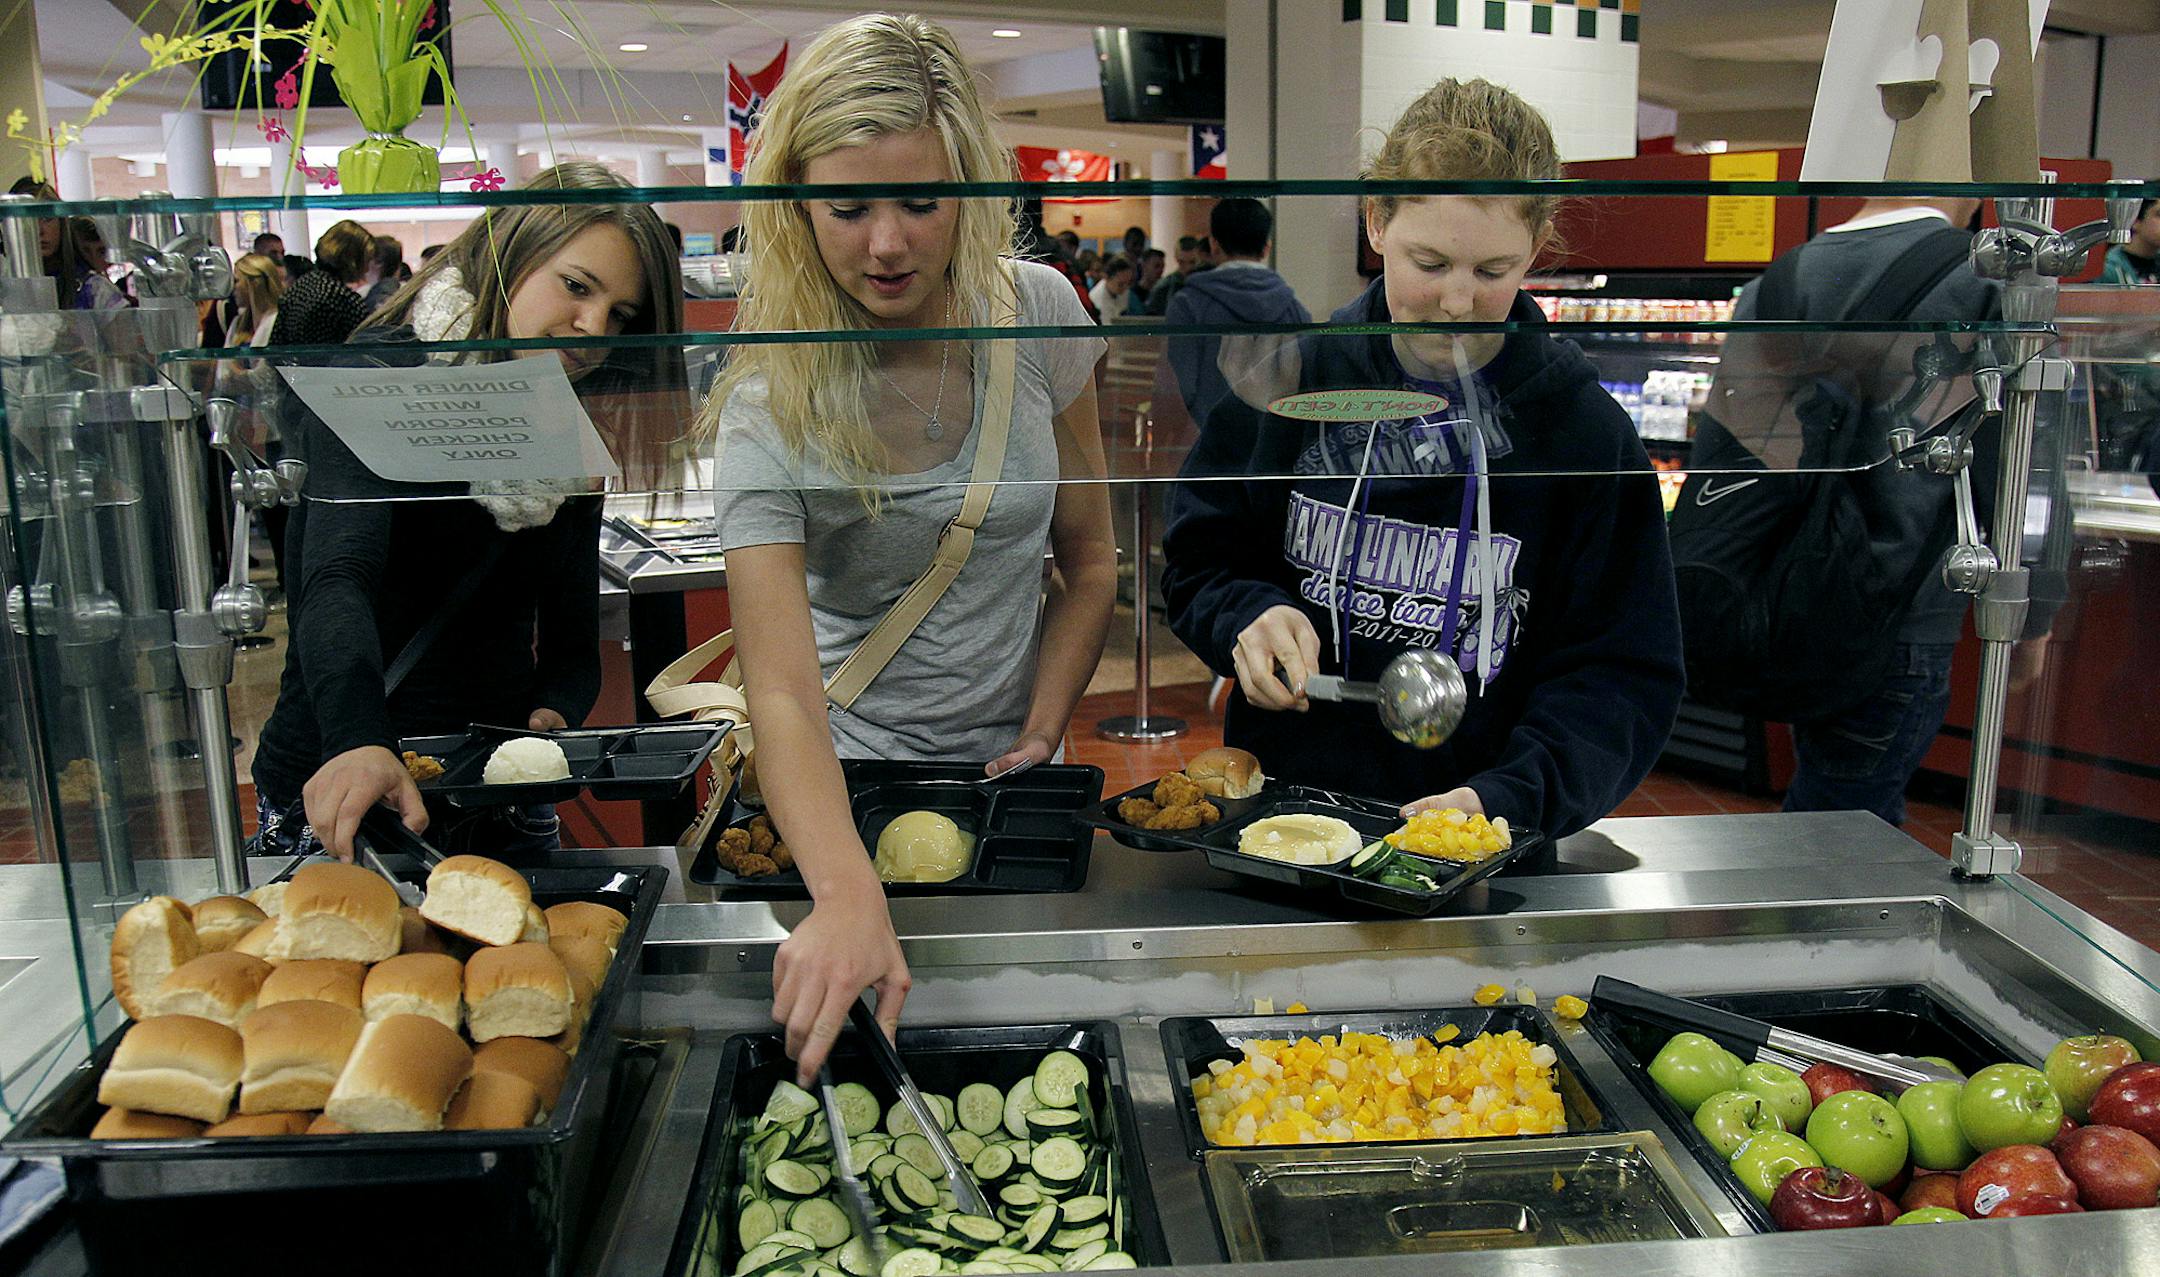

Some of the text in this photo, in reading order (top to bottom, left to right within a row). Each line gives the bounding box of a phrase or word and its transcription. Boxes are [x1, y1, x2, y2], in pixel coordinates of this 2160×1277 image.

[1416, 530, 1514, 597] PARK
[1301, 571, 1386, 619] dance
[1349, 619, 1461, 650] 2011-202
